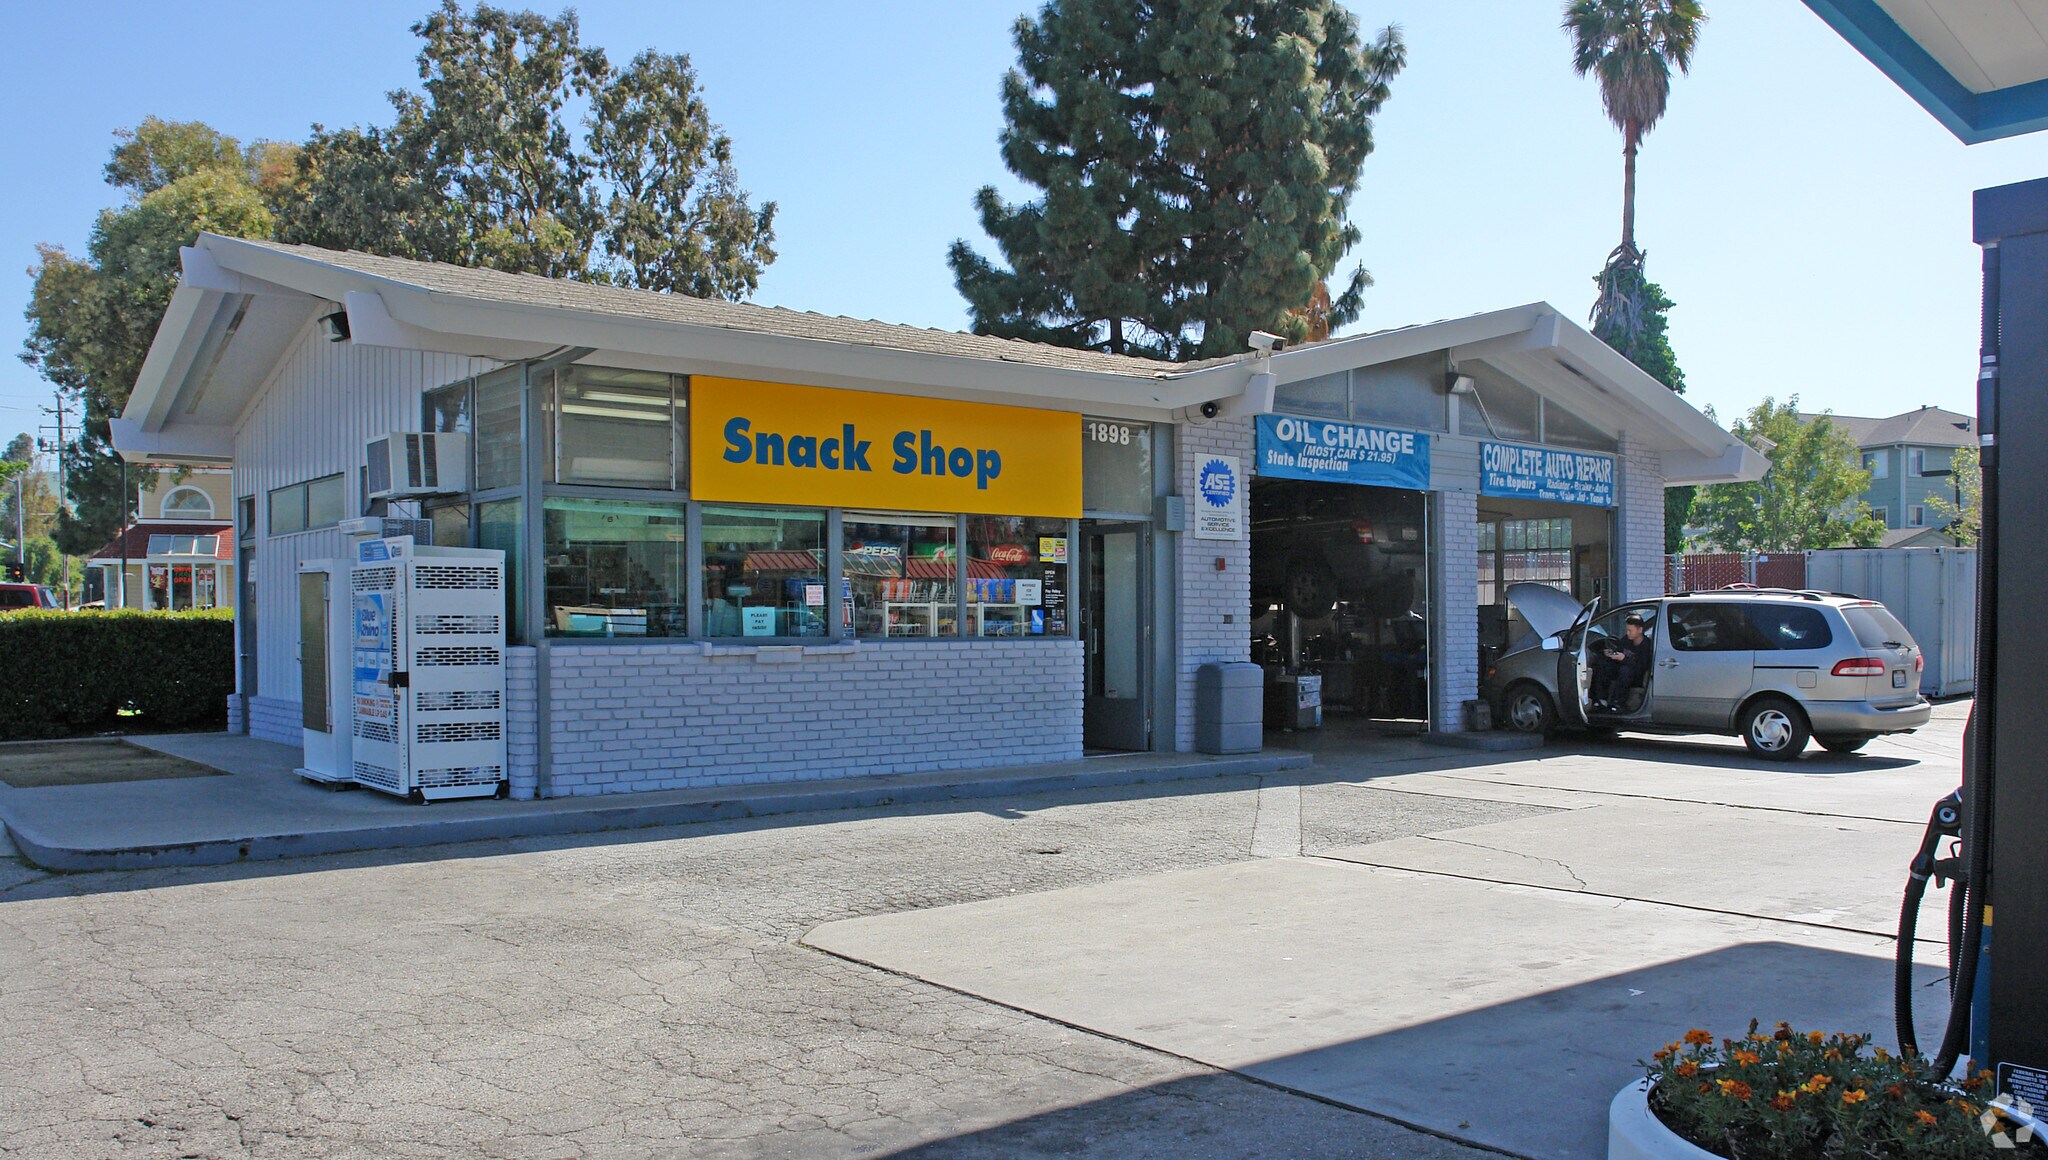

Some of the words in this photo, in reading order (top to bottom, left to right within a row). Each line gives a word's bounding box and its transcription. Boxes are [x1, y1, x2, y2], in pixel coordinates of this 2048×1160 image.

[1088, 422, 1130, 446] 1898
[1276, 418, 1317, 444] OIL
[1322, 424, 1414, 455] CHANGE
[723, 416, 872, 473] Snack
[892, 429, 1002, 491] Shop
[1267, 449, 1294, 467] State
[1297, 453, 1349, 473] Inspection
[1303, 444, 1336, 459] (MOST
[1337, 449, 1357, 460] CAR
[1358, 452, 1366, 462] $
[1367, 451, 1397, 465] 21.95)
[1483, 443, 1543, 477] COMPLETE
[1545, 452, 1574, 480] AUTO
[1576, 455, 1612, 483] REPAIR
[1203, 472, 1231, 491] ASE
[1489, 472, 1505, 486] Tire
[1506, 475, 1537, 492] Repairs
